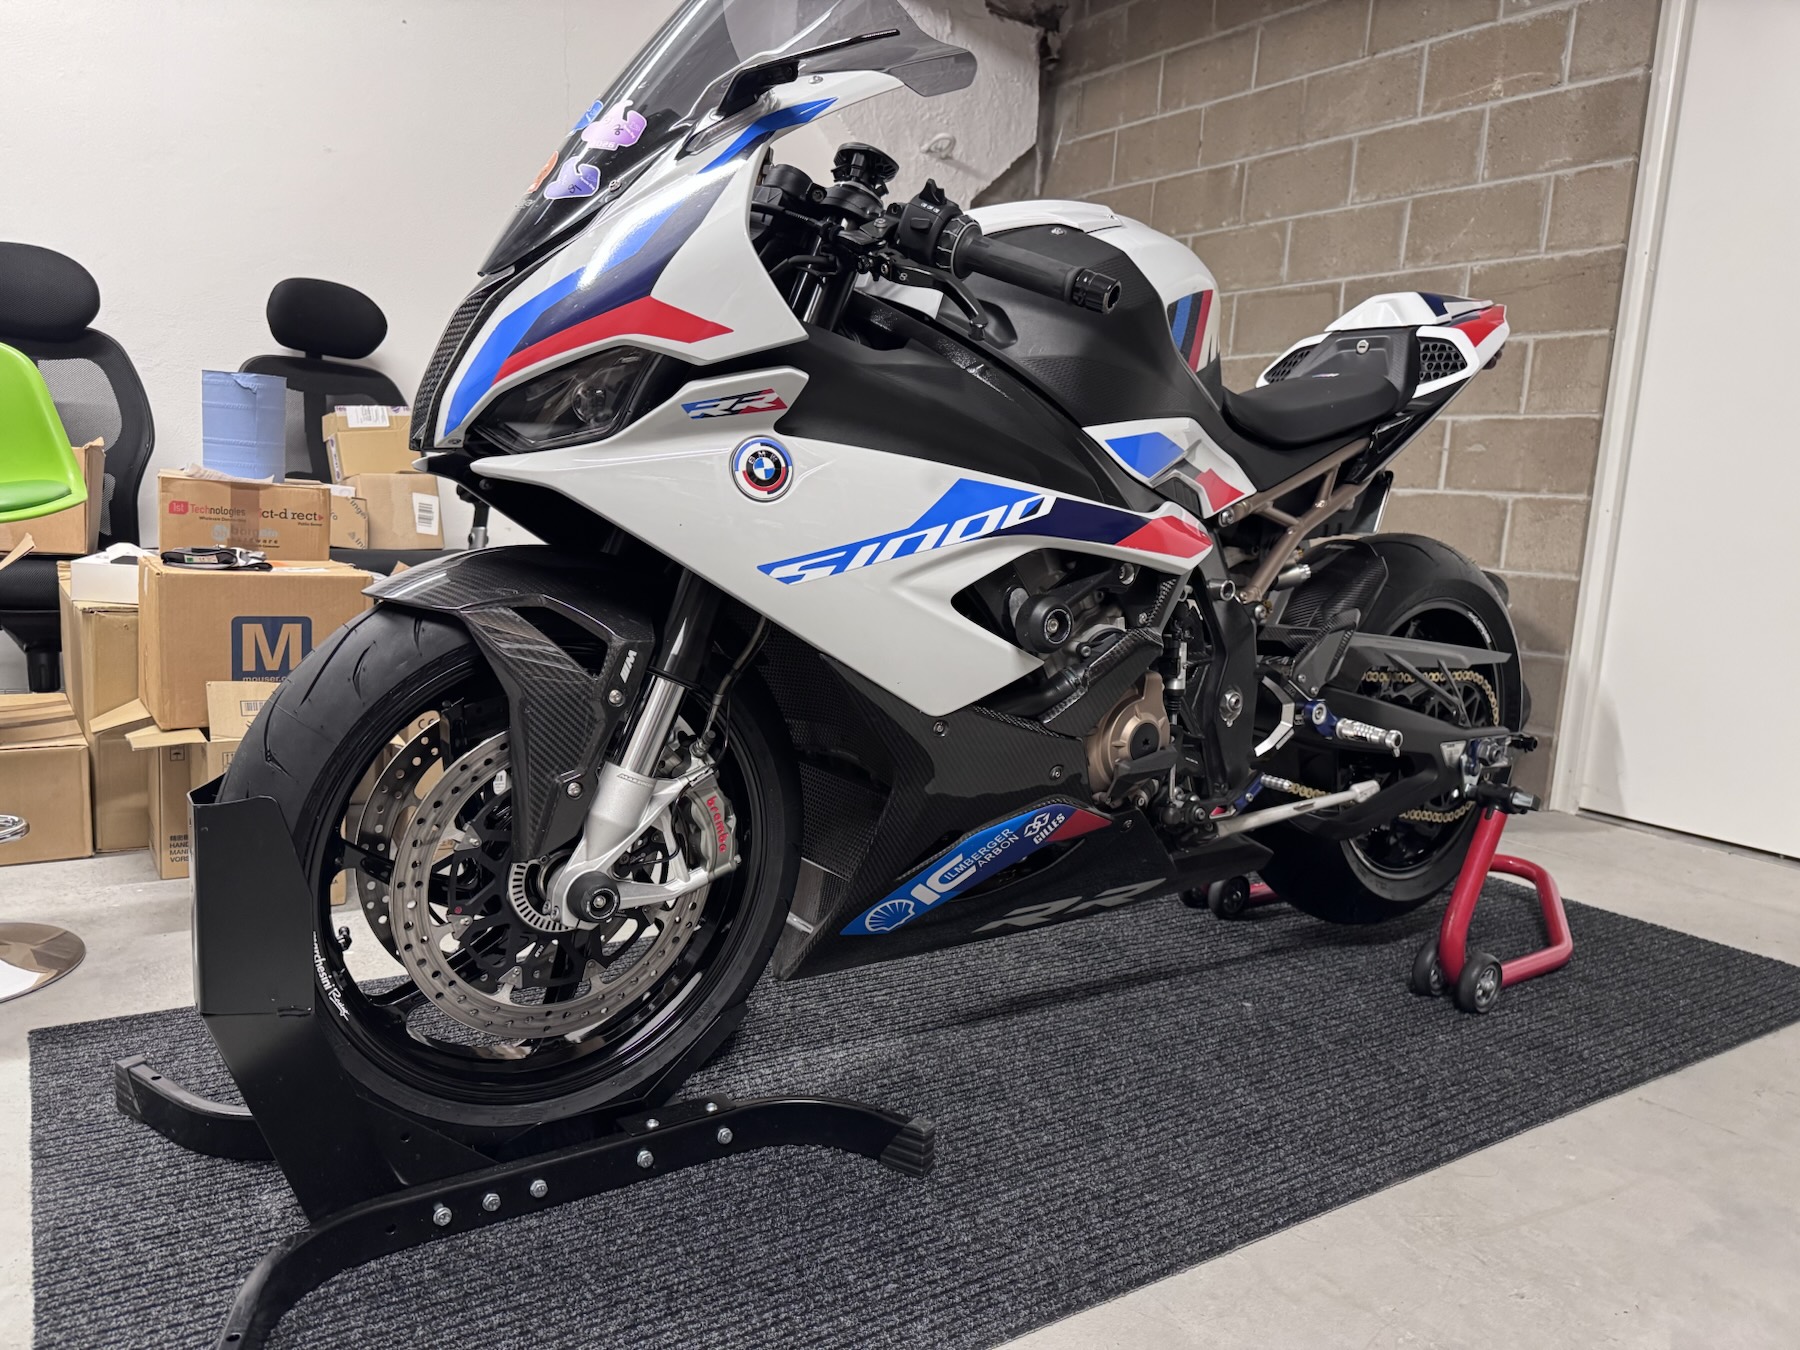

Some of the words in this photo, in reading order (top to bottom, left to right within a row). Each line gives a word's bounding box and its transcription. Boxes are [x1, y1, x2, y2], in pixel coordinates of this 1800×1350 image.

[748, 451, 778, 465] BMW
[190, 503, 246, 517] Technologies
[768, 494, 1058, 585] S1000
[242, 623, 302, 672] M
[706, 795, 729, 853] brembo
[1033, 813, 1066, 845] GILLES
[943, 828, 1014, 881] ILMBERGER
